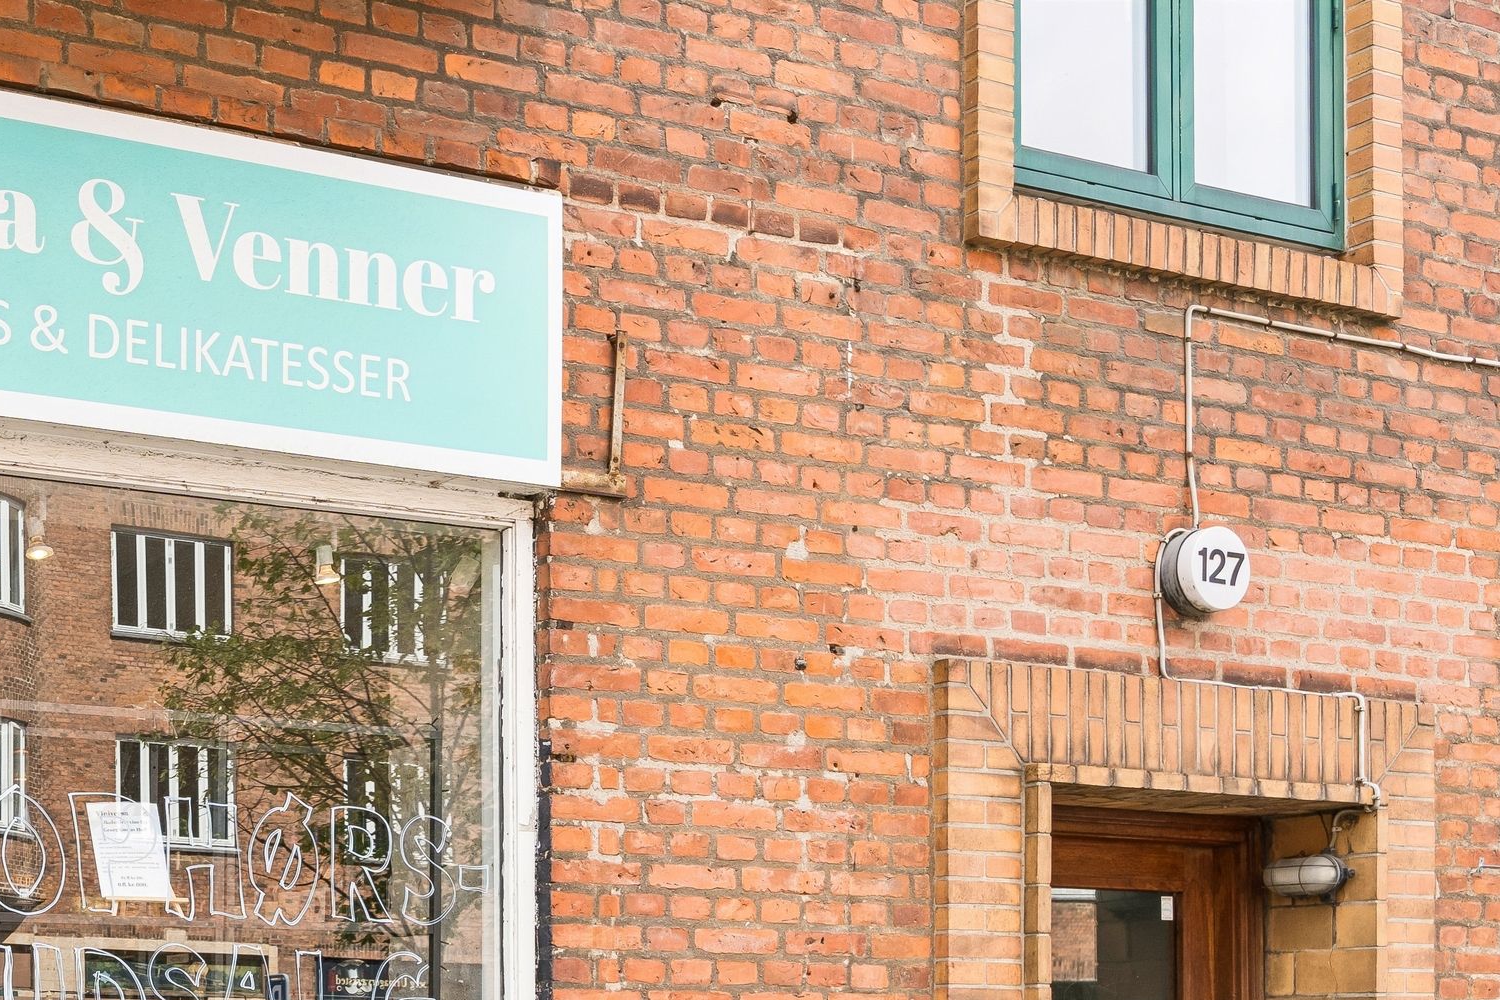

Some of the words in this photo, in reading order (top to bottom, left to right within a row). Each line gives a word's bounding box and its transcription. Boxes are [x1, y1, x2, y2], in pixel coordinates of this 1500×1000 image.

[71, 177, 143, 295] &
[170, 191, 496, 324] Venner
[30, 304, 69, 355] &
[88, 312, 413, 403] DELIKATESSER
[1198, 547, 1245, 587] 127
